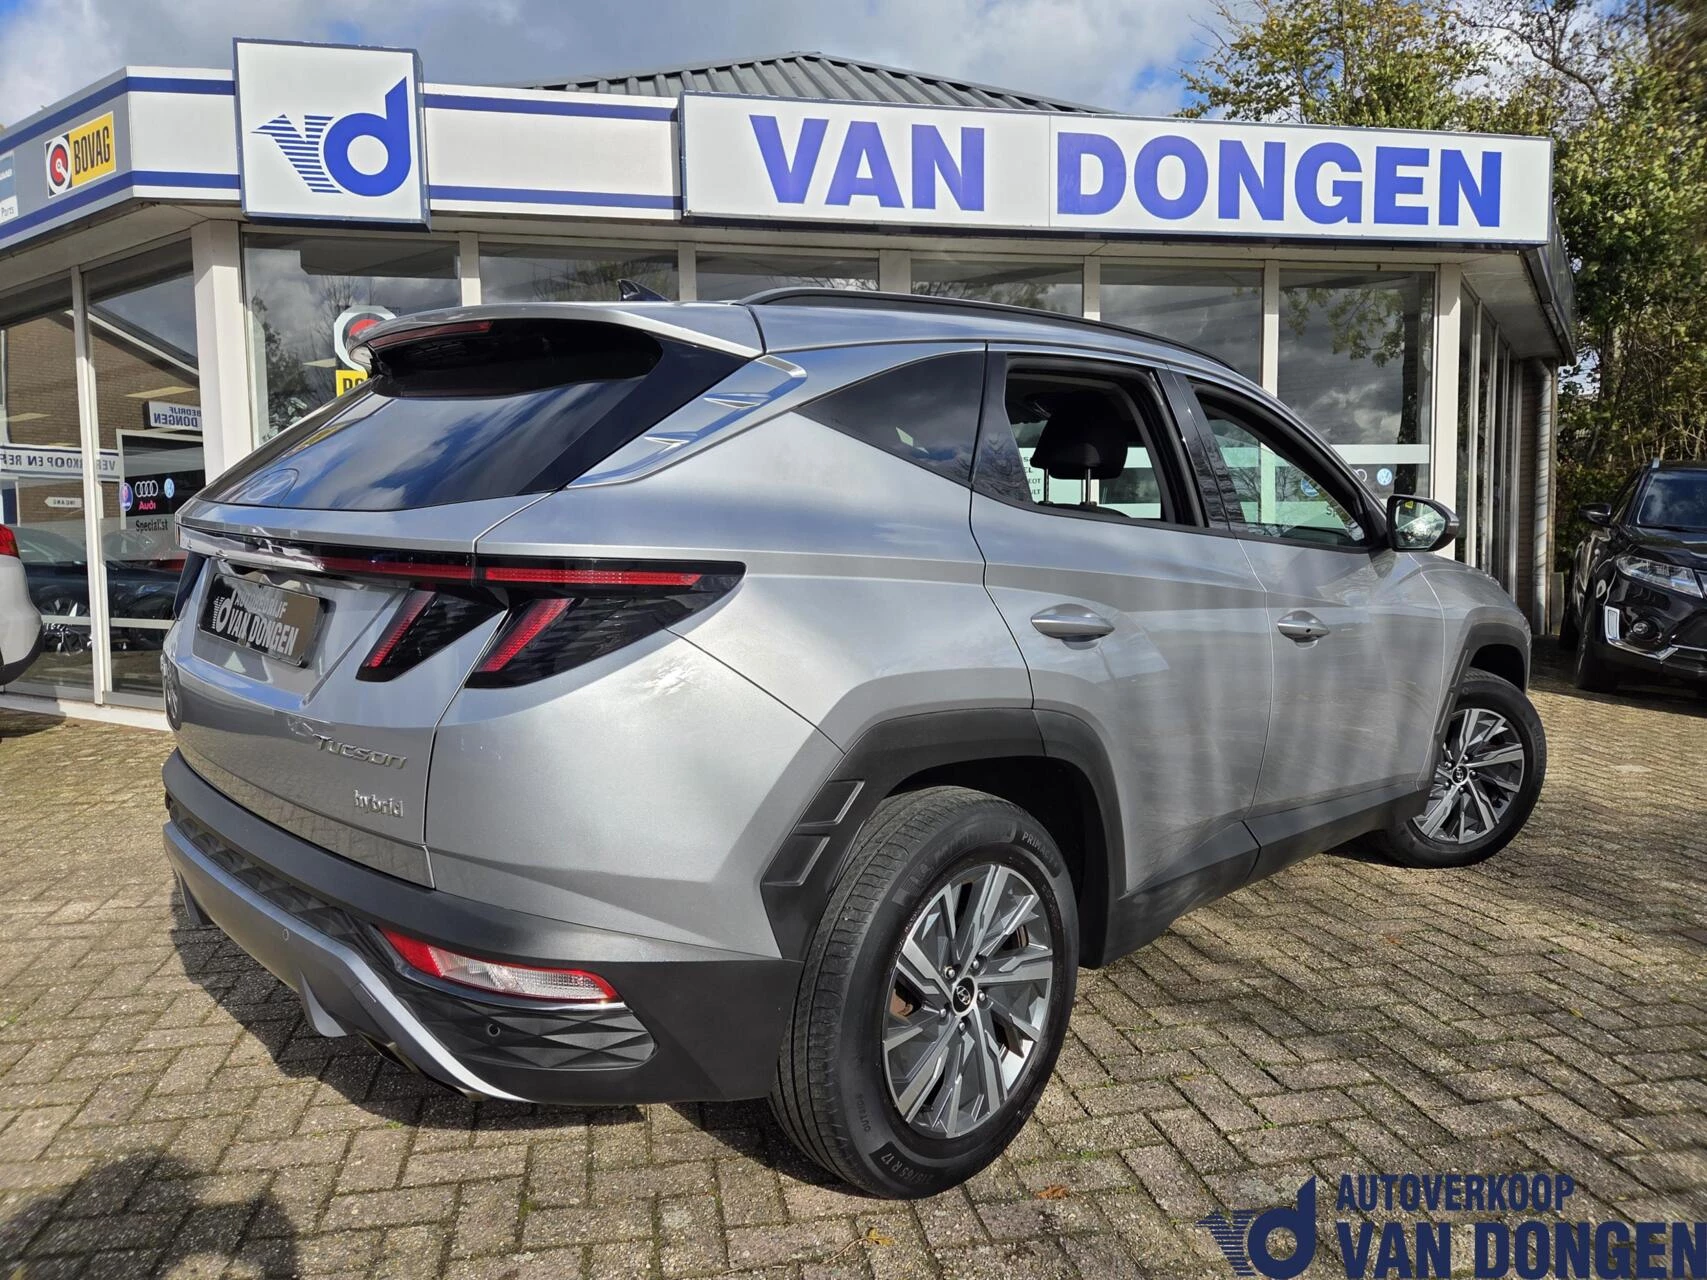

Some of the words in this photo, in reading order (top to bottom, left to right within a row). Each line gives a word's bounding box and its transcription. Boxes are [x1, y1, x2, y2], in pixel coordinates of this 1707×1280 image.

[73, 126, 111, 175] BOVAG
[749, 114, 985, 212] VAN
[1057, 131, 1502, 228] DONGEN
[139, 501, 156, 510] Audi
[227, 608, 251, 640] VAN
[248, 615, 299, 656] DONGEN
[354, 789, 403, 817] hybrid
